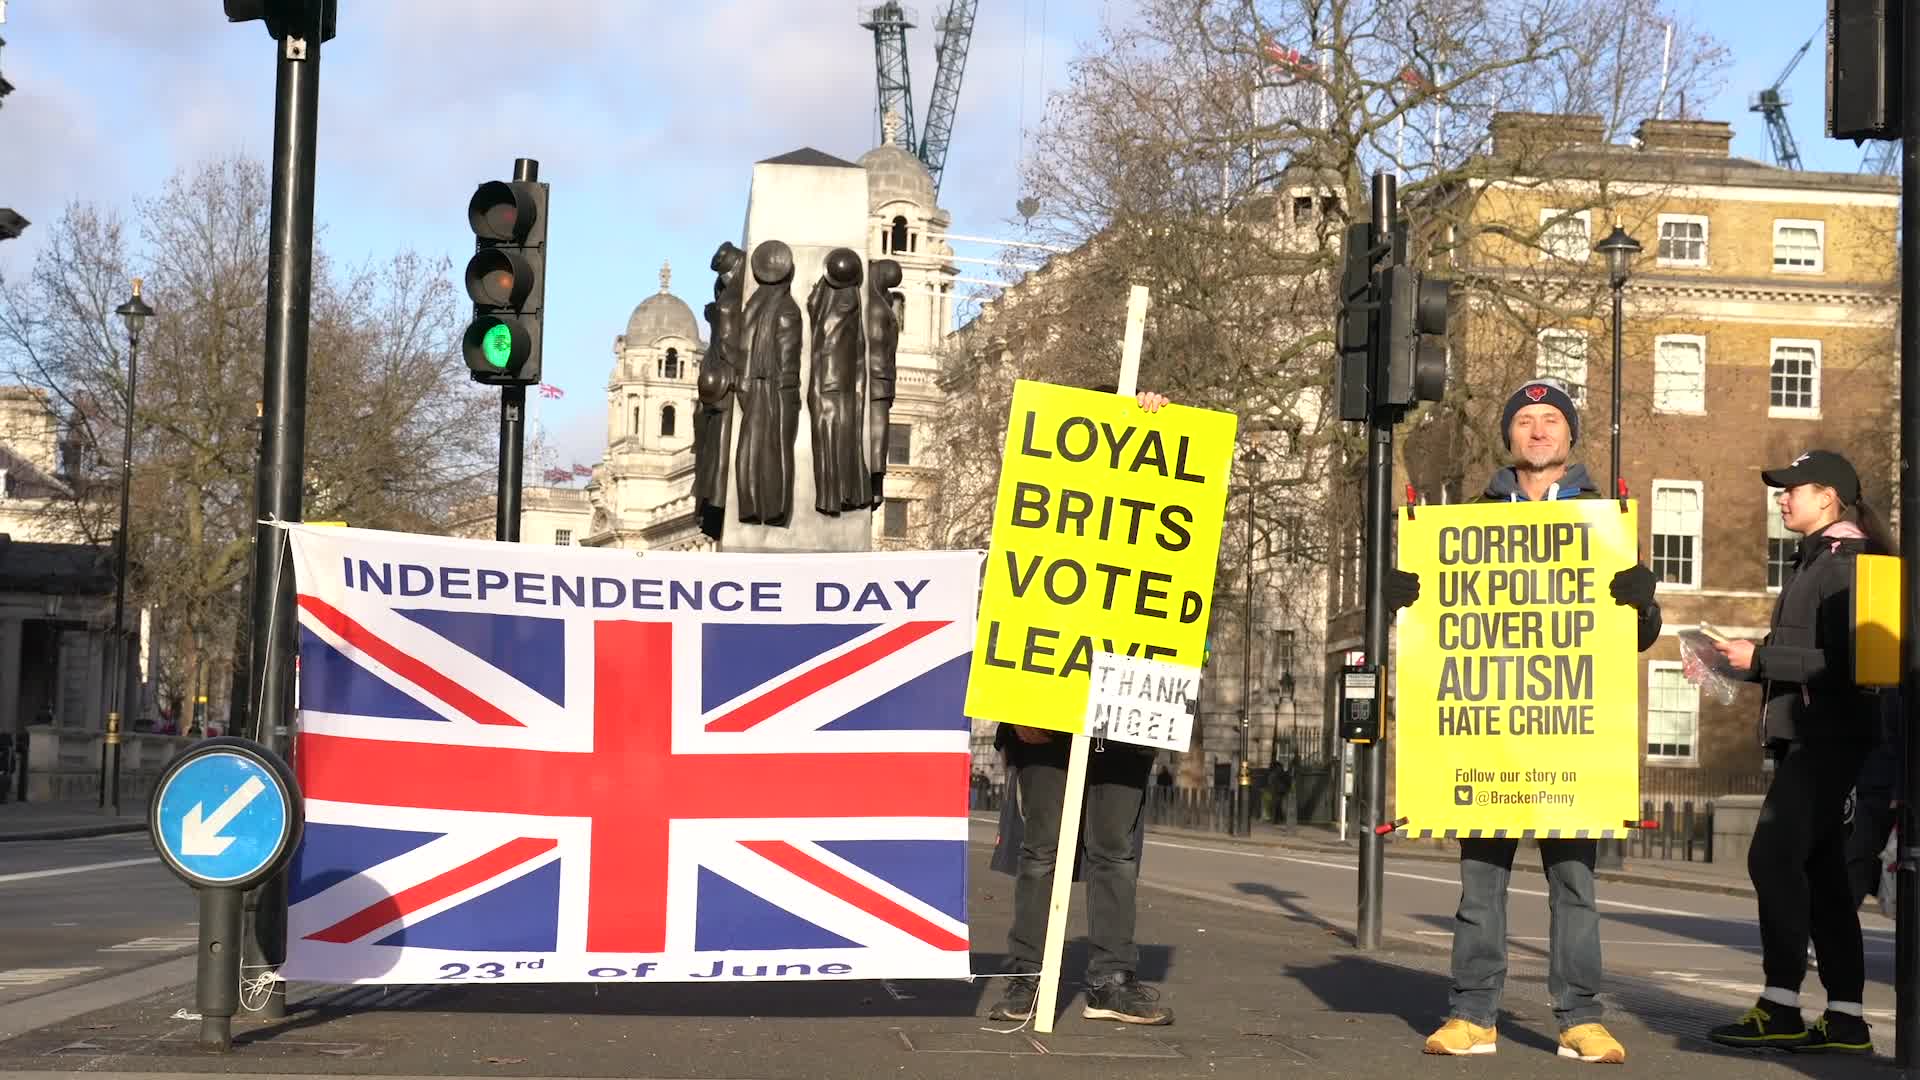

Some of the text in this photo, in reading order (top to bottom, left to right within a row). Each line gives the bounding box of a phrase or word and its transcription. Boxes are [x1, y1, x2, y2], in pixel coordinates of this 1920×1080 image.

[1021, 410, 1206, 484] LOYAL
[1011, 481, 1194, 552] BRITS
[1438, 522, 1594, 565] CORRUPT
[343, 556, 931, 612] INDEPENDENCE DAY
[1005, 550, 1203, 624] VOTED
[1439, 567, 1596, 607] UK POLICE
[1438, 610, 1595, 650] COVER UP
[1098, 665, 1192, 705] THANK
[1436, 654, 1594, 701] AUTISM
[1093, 703, 1178, 742] NIGEL
[1438, 704, 1595, 736] HATE CRIME
[1455, 768, 1577, 785] Follow our story on
[1475, 790, 1575, 807] @BrackenPenny
[438, 958, 853, 980] 23rd of June
